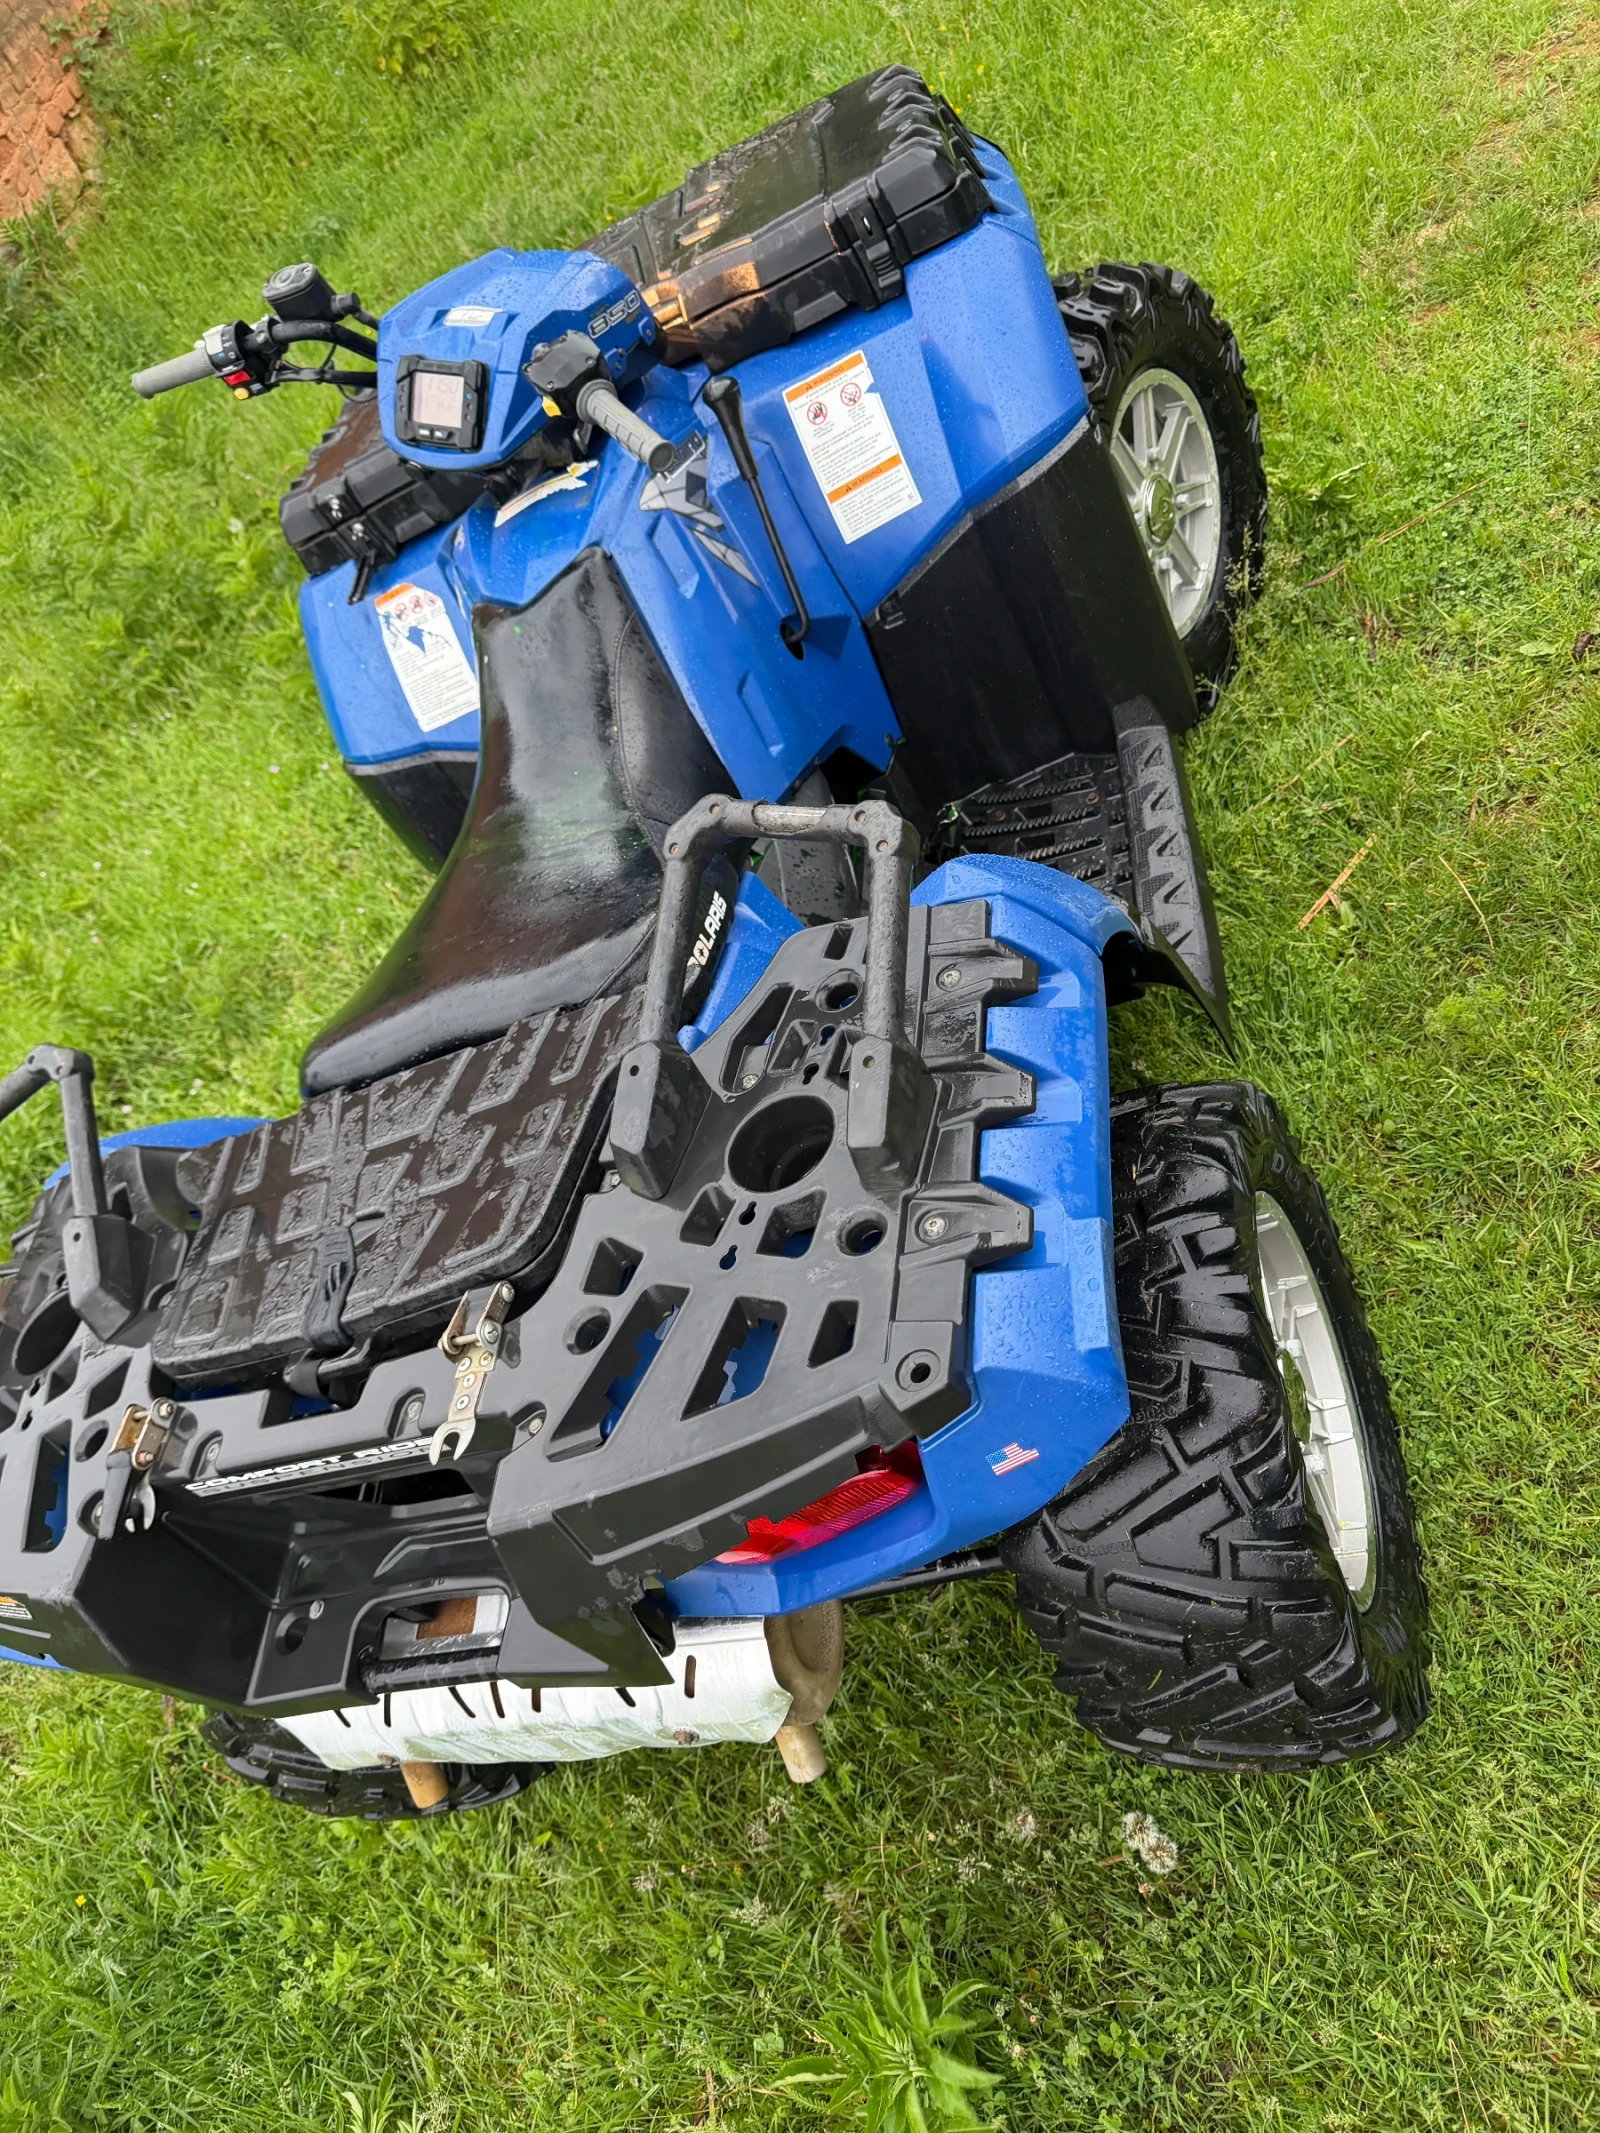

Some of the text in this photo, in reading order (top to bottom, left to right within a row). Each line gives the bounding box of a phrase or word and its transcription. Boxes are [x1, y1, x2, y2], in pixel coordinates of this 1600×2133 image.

[588, 290, 640, 338] 850
[813, 365, 844, 386] WARNING
[852, 466, 882, 487] WARNING
[185, 1455, 342, 1490] COMFORT
